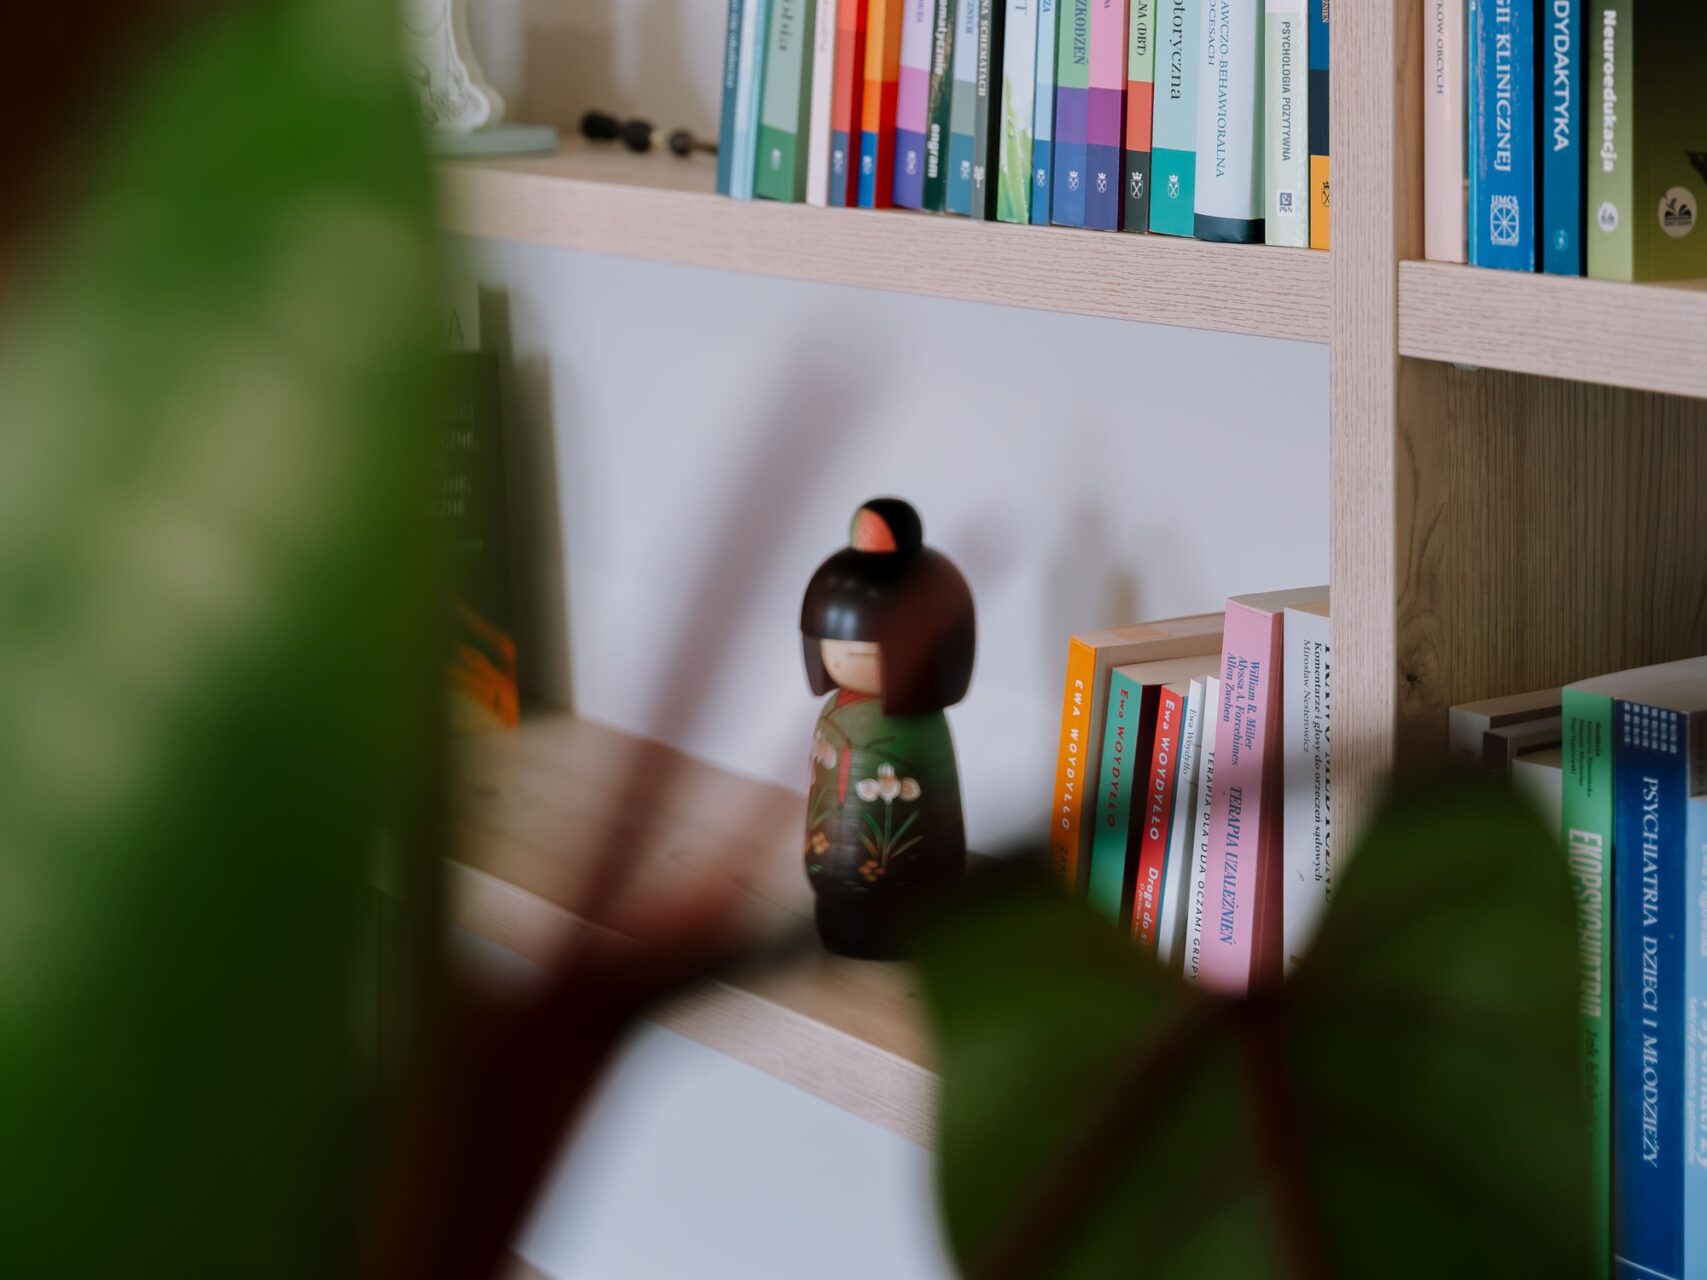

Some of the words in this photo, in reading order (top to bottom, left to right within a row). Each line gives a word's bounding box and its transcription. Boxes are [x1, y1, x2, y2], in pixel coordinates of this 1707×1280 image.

[980, 0, 990, 15] NA
[977, 20, 989, 96] SCHEMATACH
[1135, 22, 1147, 56] (DBT)
[1282, 21, 1292, 94] PSYCHOLOGIA
[1436, 38, 1444, 95] OBCYCH
[1493, 31, 1512, 172] KLINICZNEJ
[1600, 9, 1618, 173] Neuroedukacja
[927, 124, 941, 178] engram
[1281, 97, 1291, 161] POZYTYWNA
[1225, 652, 1237, 680] Allen
[1235, 656, 1249, 688] Alyssa
[1247, 661, 1261, 700] William
[1303, 639, 1312, 688] Mirosław
[1313, 641, 1323, 712] Komentarze
[1071, 679, 1084, 717] EWA
[1117, 688, 1129, 719] Ewa
[1161, 698, 1175, 729] Ewa
[1187, 709, 1196, 728] Ewa
[1222, 683, 1235, 722] Zweben
[1303, 690, 1311, 753] Nesterowicz
[1182, 731, 1195, 775] Woydyłło
[1230, 707, 1244, 766] Forcehimes
[1243, 718, 1256, 750] Miller
[1062, 728, 1080, 830] WOYDYŁŁO
[1106, 726, 1125, 827] WOYDYŁŁO
[1149, 737, 1171, 840] WOYDYŁŁO
[1204, 751, 1216, 807] TERAPIA
[1314, 772, 1323, 823] orzeczeń
[1225, 785, 1243, 847] TERAPIA
[1312, 826, 1323, 882] sądowych
[1642, 776, 1659, 927] PSYCHIATRIA
[1143, 867, 1159, 909] Droga
[1193, 880, 1206, 933] OCZAMI
[1219, 851, 1240, 945] UZALEŻNIEŃ
[1643, 936, 1659, 1010] DZIECI
[1642, 1034, 1661, 1168] MŁODZIEŻY
